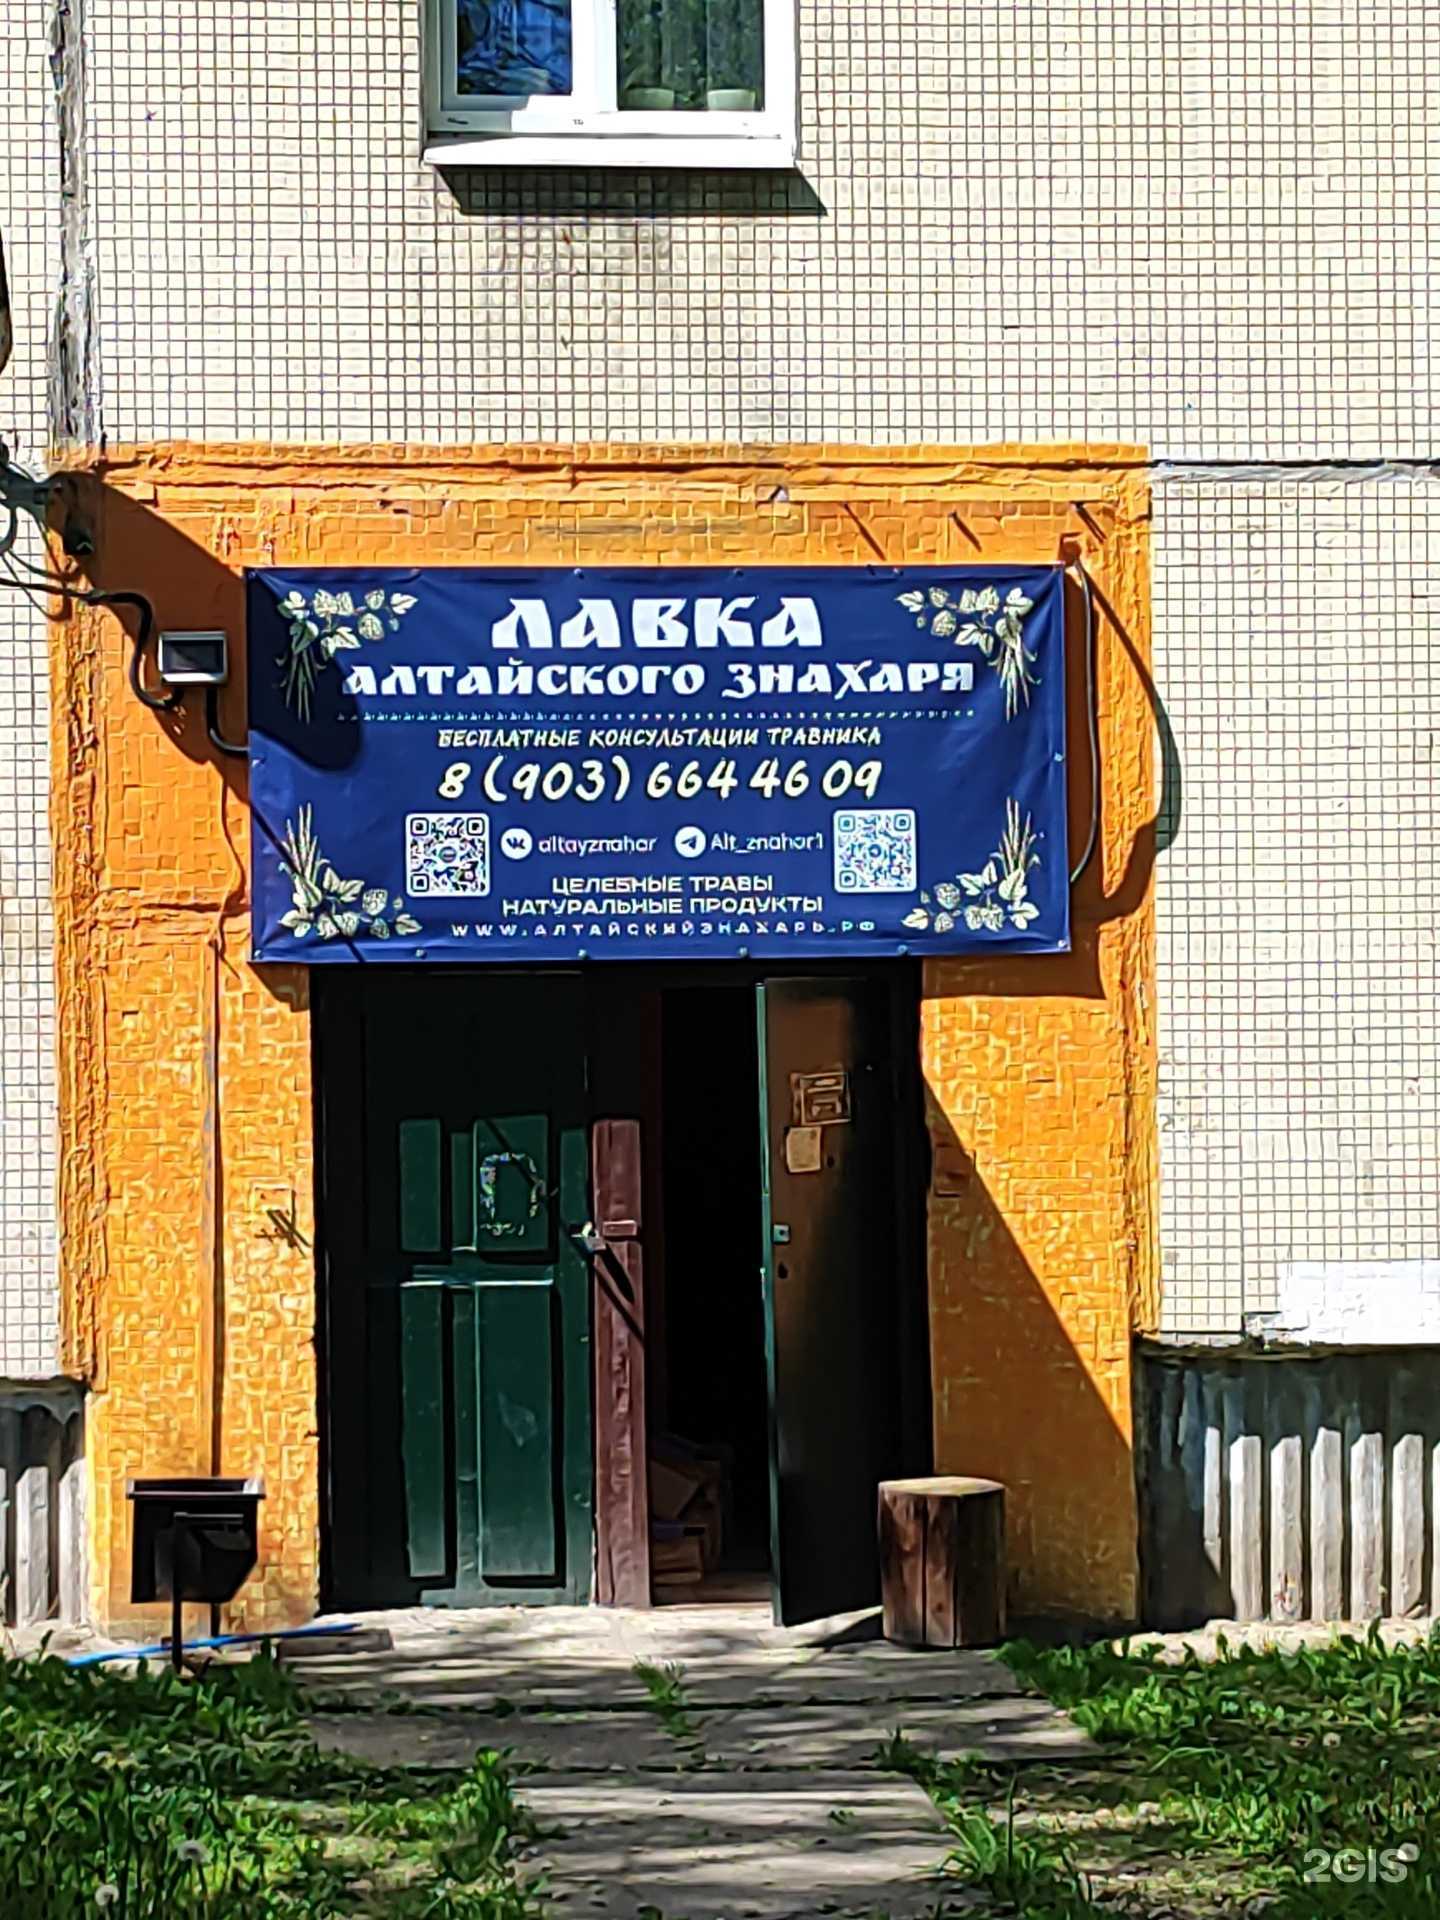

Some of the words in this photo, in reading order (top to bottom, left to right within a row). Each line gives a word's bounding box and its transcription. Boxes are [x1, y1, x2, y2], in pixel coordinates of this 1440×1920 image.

[491, 597, 823, 649] ЛАВКА
[343, 657, 705, 696] АЛТАЙСКОГО
[722, 659, 974, 699] ЗНАХАРЯ
[438, 728, 581, 749] БЕСПЛАТНЫЕ
[588, 727, 758, 750] КОНСУЛЬТАЦИИ
[766, 727, 881, 747] ТРАВНИКА
[438, 762, 471, 799] 8
[484, 755, 631, 801] (903)
[646, 758, 738, 801] 664
[749, 757, 809, 801] 46
[822, 759, 882, 801] 09
[538, 835, 657, 857] altayznahar
[552, 875, 683, 896] ЦЕЛЕБНЫЕ
[688, 874, 773, 893] ТРАВЫ
[502, 897, 683, 917] НАТУРАЛЬНЫЕ
[689, 896, 823, 915] ПРОДУКТЫ
